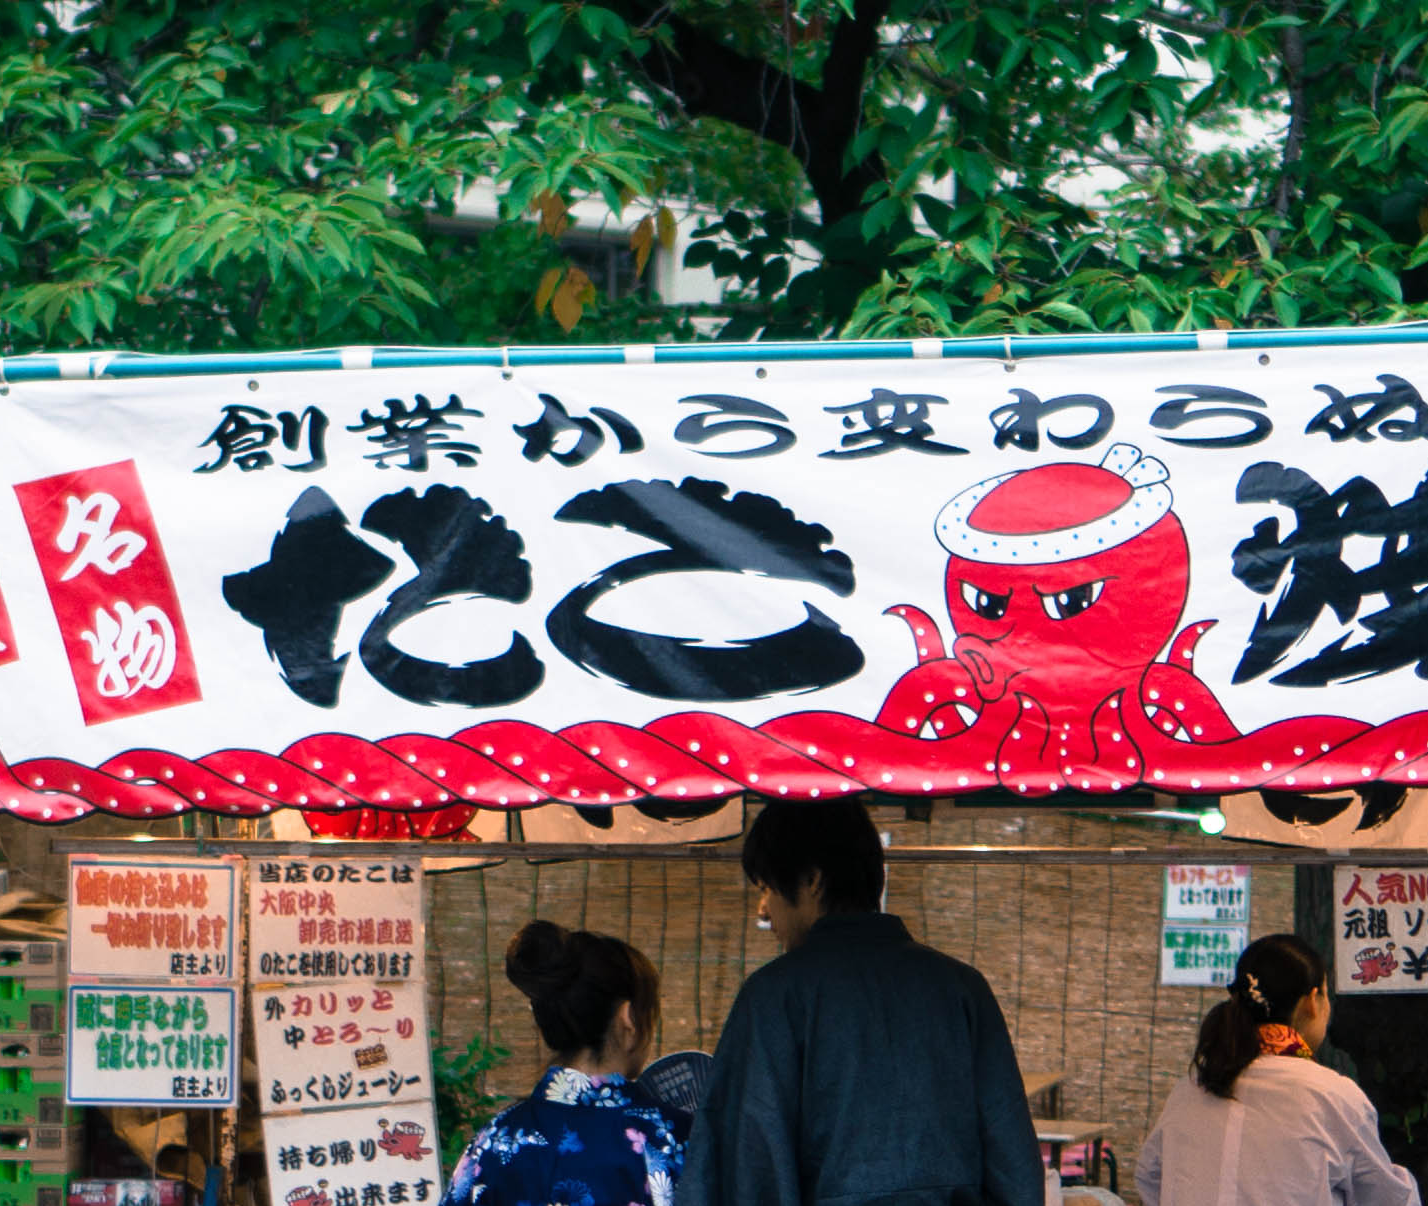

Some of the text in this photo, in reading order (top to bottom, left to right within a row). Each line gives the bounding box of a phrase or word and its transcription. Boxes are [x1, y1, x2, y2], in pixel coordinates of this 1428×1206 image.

[56, 492, 177, 699] 名物
[259, 864, 415, 885] 当店のたこは
[259, 890, 336, 917] 大阪中央
[298, 918, 413, 946] 卸売市場直送
[1343, 907, 1391, 940] 元祖
[171, 952, 226, 976] 店主より
[260, 952, 415, 978] のたこを使用しております
[172, 1076, 228, 1098] 店主より
[271, 1072, 422, 1105] ふっくらジューシー
[278, 1138, 377, 1172] 持ち帰り
